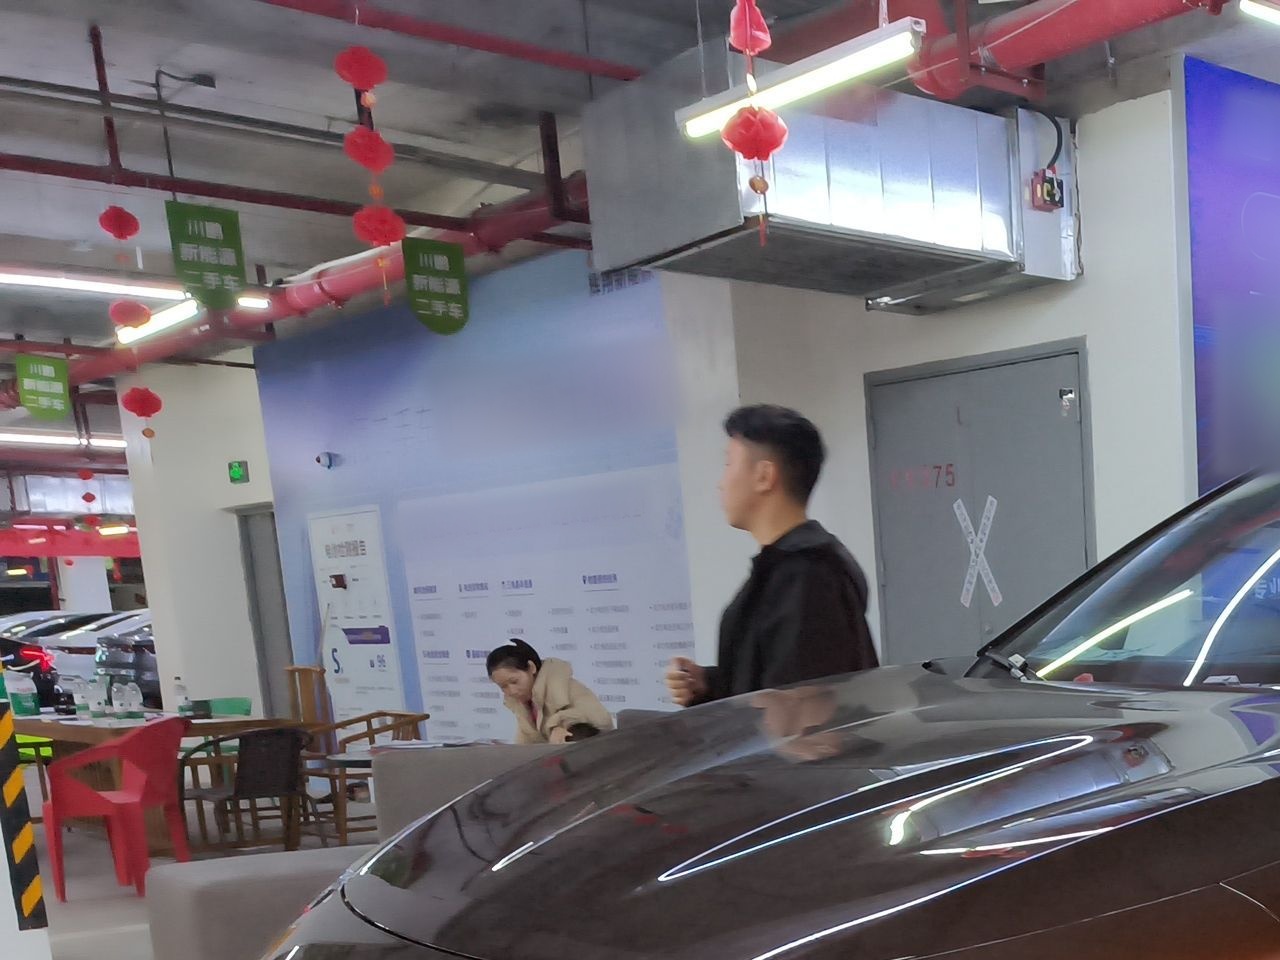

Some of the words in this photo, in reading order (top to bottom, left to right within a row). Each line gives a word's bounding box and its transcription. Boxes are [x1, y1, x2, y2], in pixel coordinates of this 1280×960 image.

[184, 269, 243, 290] 二手车
[416, 298, 464, 319] 二手车
